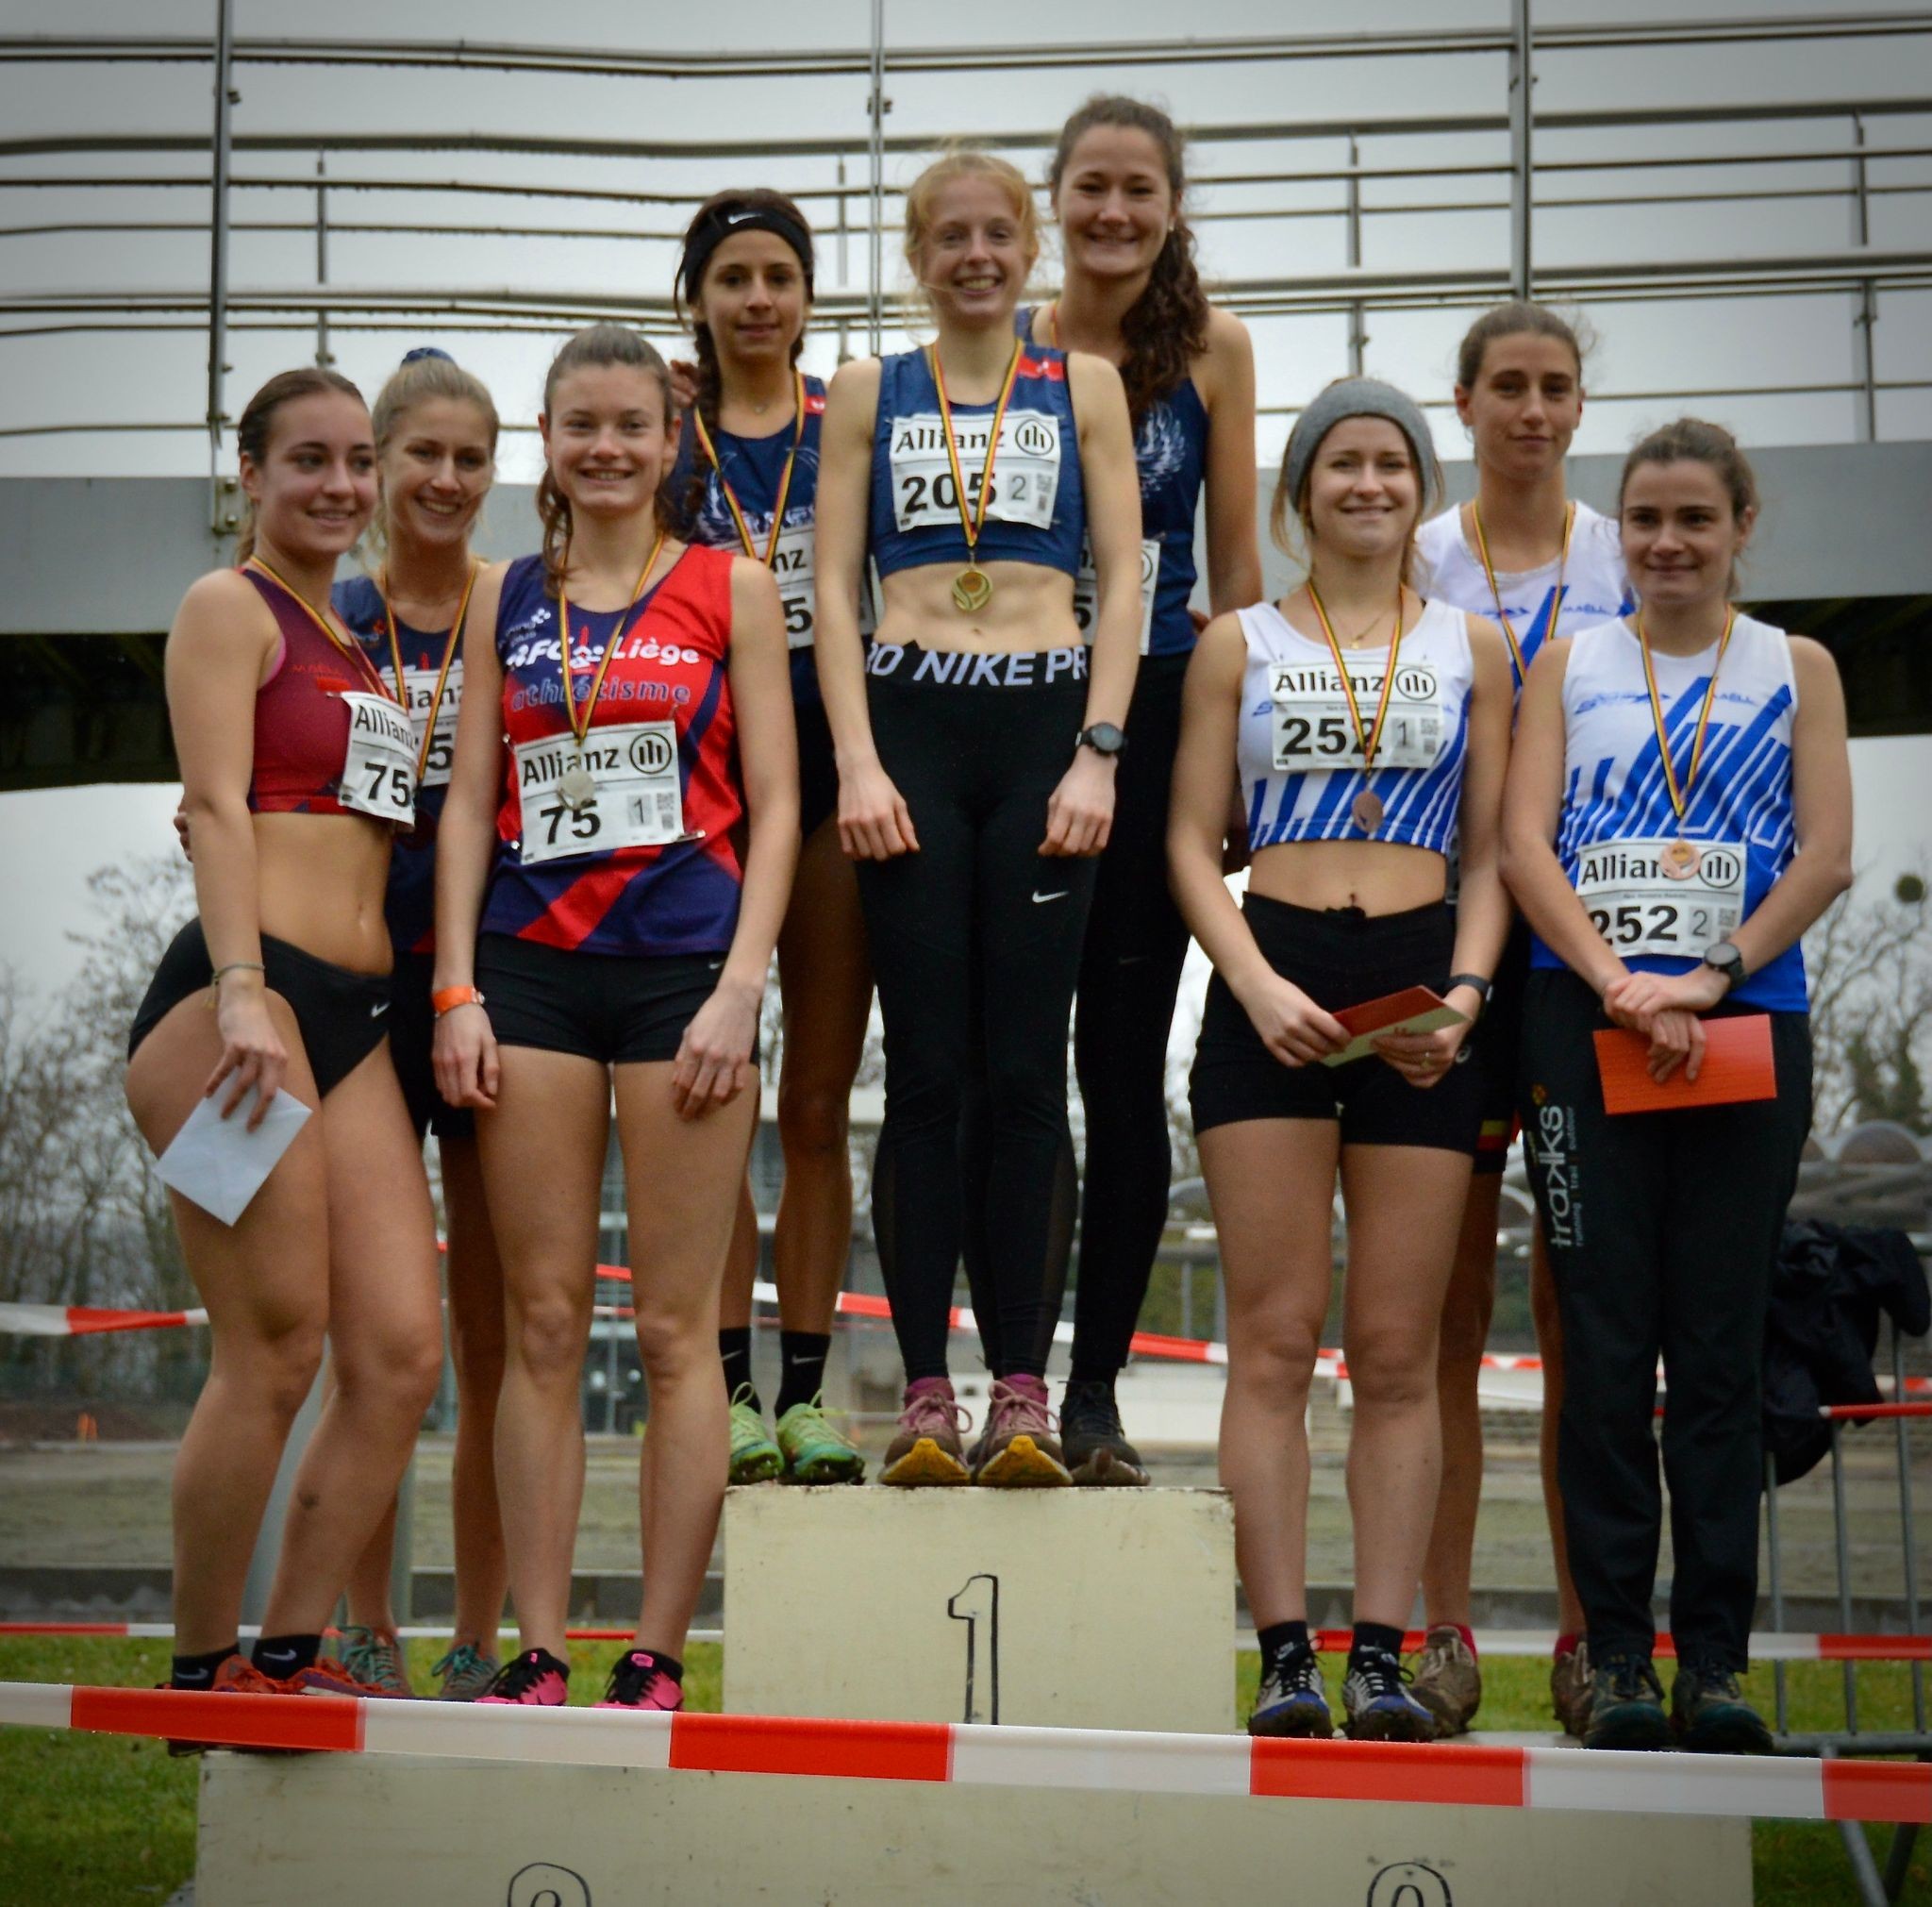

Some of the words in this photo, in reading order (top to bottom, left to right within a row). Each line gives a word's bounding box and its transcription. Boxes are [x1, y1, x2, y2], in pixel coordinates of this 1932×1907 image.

[901, 473, 997, 513] 205
[1010, 475, 1026, 501] 2
[610, 635, 700, 666] Liège
[913, 649, 1036, 686] NIKE
[512, 675, 691, 712] athétisme
[1274, 671, 1386, 693] Allianz
[1281, 718, 1382, 756] 252
[1397, 722, 1407, 746] 1
[364, 761, 410, 808] 75
[523, 748, 620, 787] Allianz
[540, 799, 601, 845] 75
[633, 798, 645, 826] 1
[1581, 854, 1667, 885] Allian
[1589, 905, 1678, 945] 252
[1693, 911, 1707, 936] 2
[1539, 1105, 1573, 1248] trakks
[948, 1574, 998, 1725] 1
